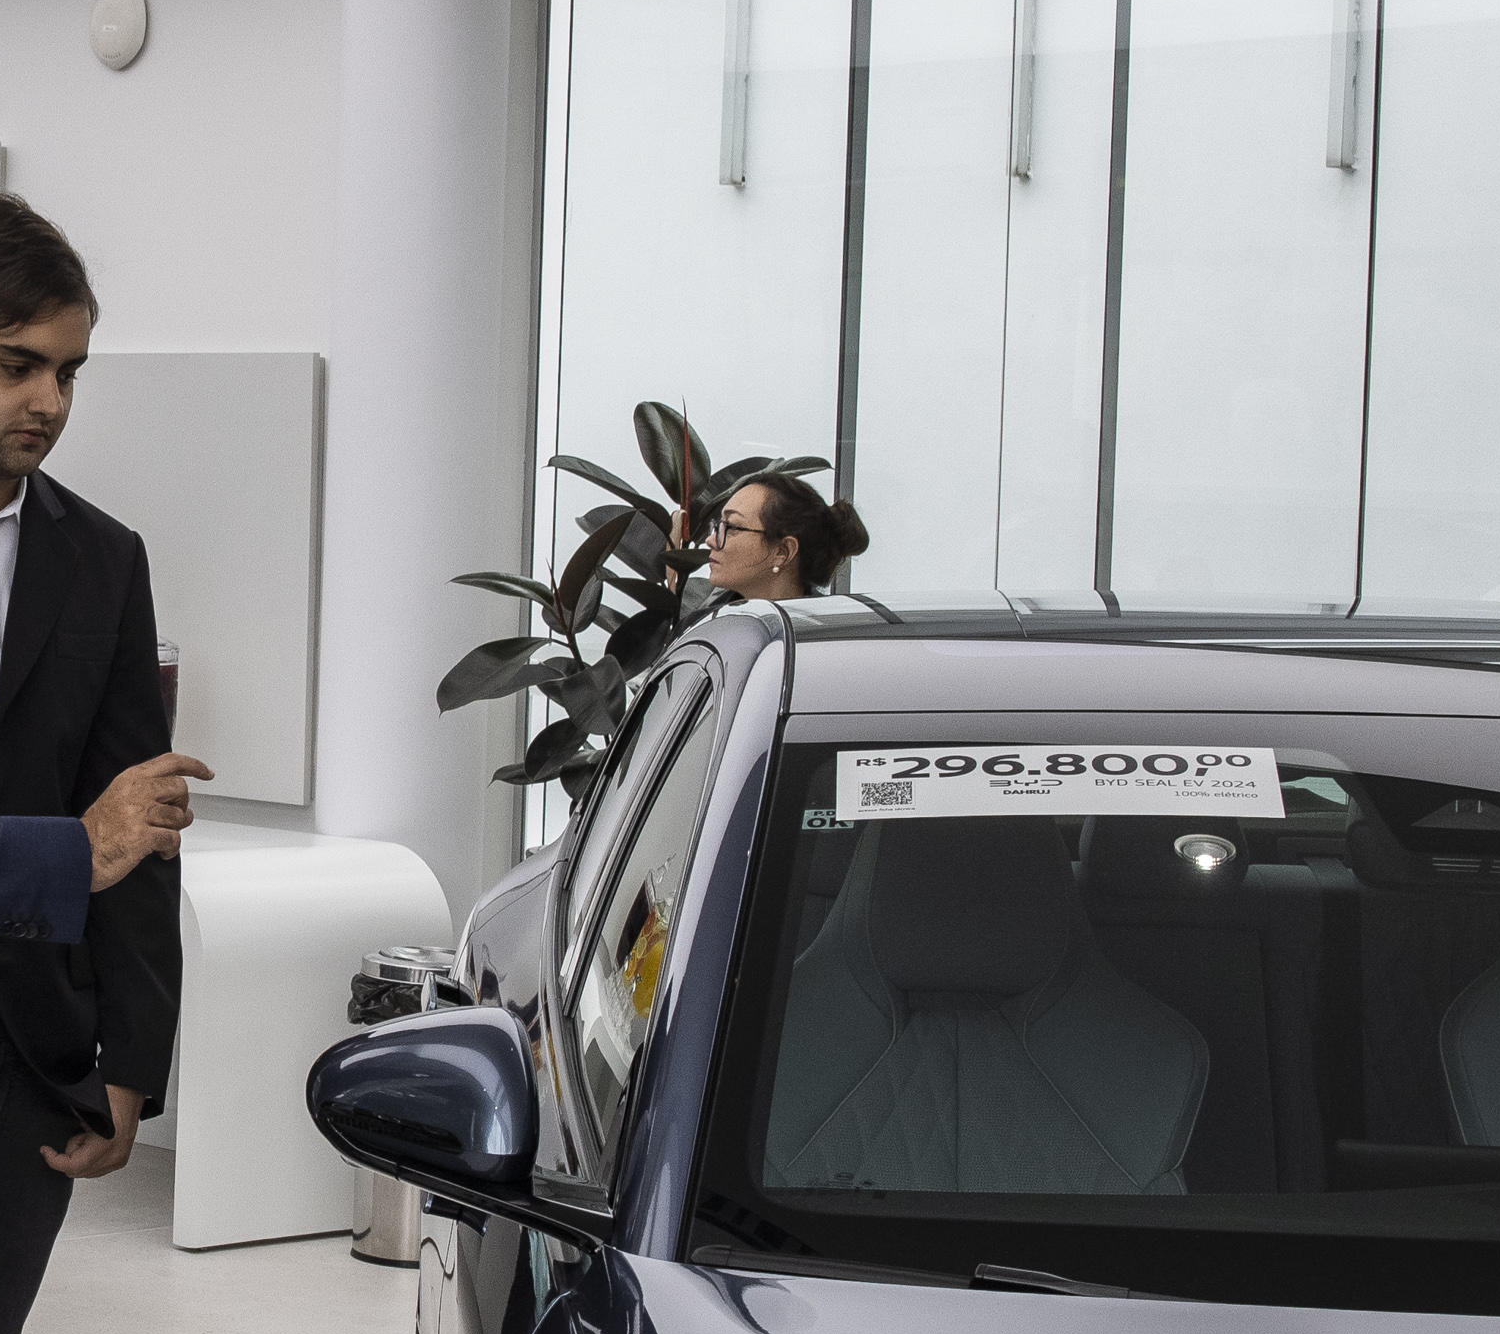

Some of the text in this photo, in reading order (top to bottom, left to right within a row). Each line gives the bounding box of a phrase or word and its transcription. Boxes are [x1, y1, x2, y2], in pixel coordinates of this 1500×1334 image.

[856, 753, 1252, 779] R$ 296.800,00
[988, 779, 1064, 788] BYD
[1094, 778, 1257, 788] BYD SEAL EV 2024
[1213, 790, 1259, 799] elétrico
